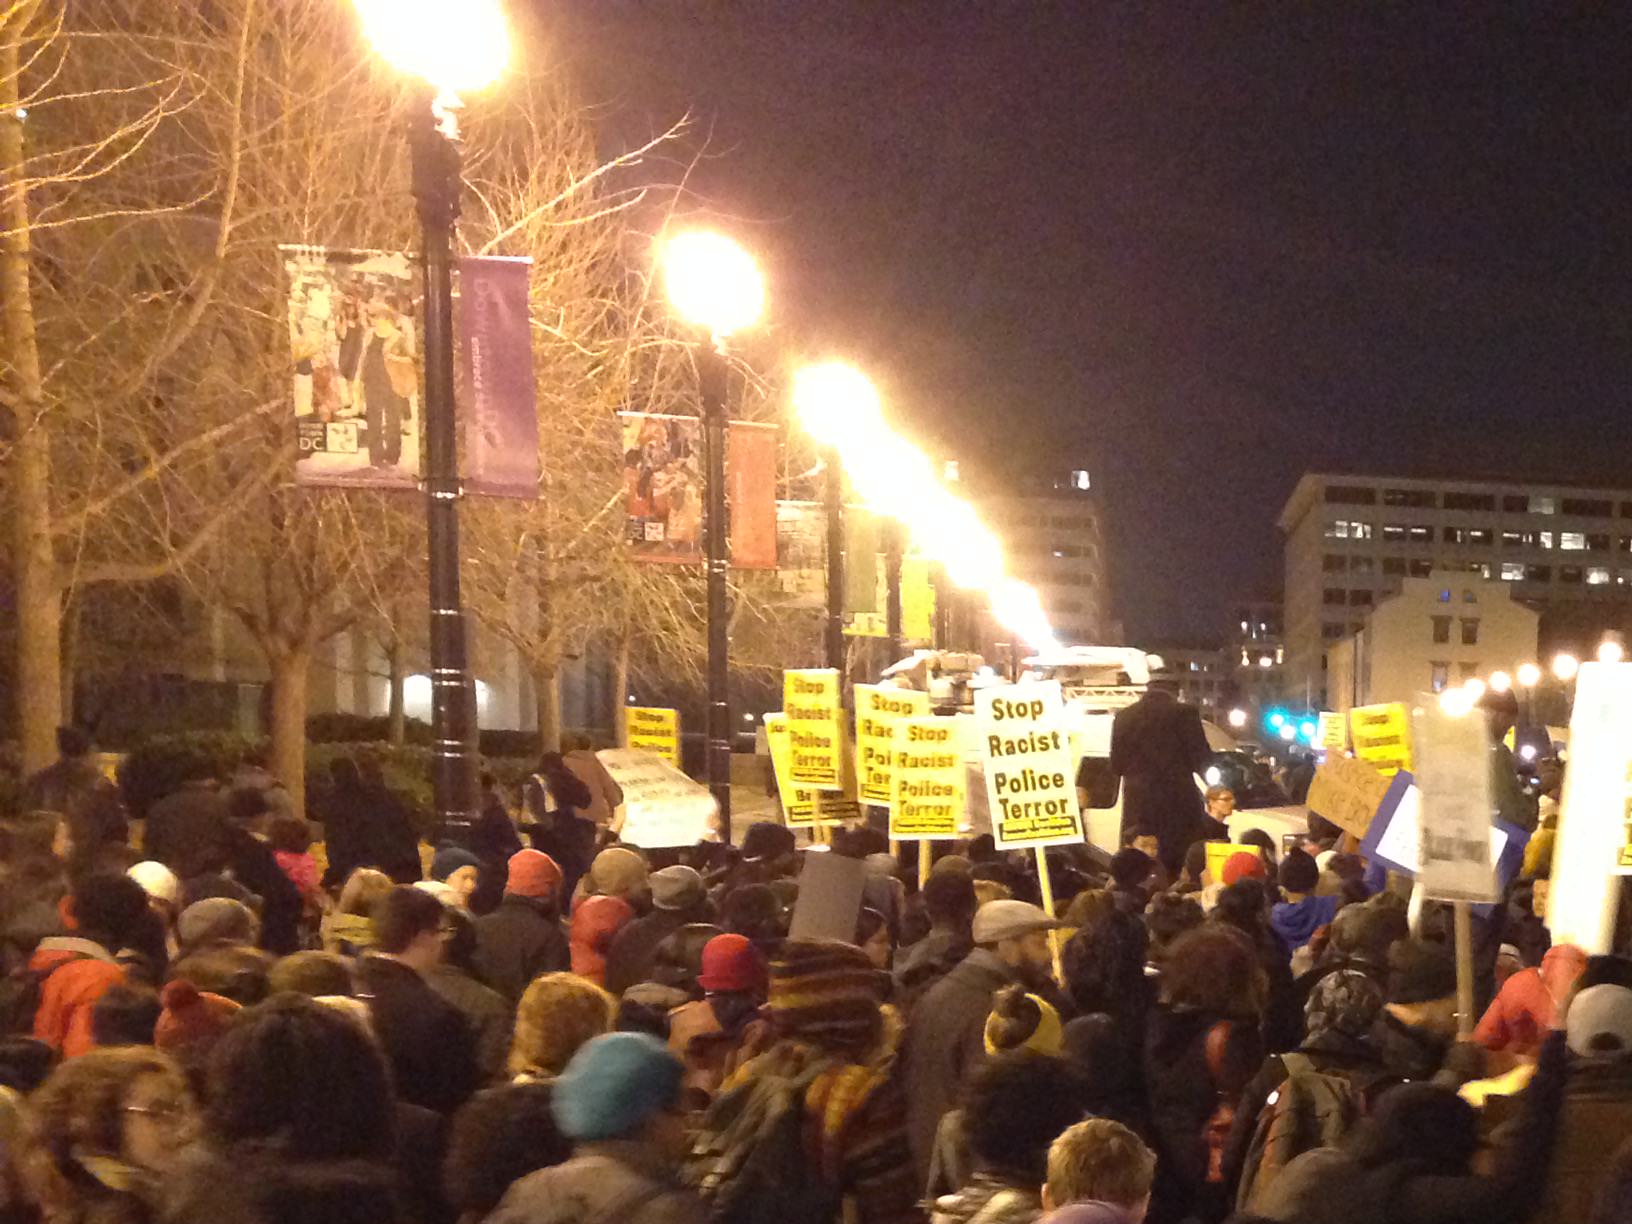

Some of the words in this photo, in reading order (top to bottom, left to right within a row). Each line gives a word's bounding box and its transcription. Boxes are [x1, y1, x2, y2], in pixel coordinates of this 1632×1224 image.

[299, 437, 323, 450] DC
[793, 677, 825, 695] Stop
[786, 703, 831, 720] Racist
[872, 694, 913, 715] Stop
[992, 698, 1044, 721] Stop
[862, 719, 893, 738] Rac
[908, 725, 948, 741] Stop
[789, 730, 831, 748] Police
[988, 731, 1060, 757] Racist
[792, 750, 831, 767] Terror
[898, 752, 955, 768] Racist
[899, 781, 953, 797] Police
[995, 769, 1064, 795] Police
[899, 800, 952, 816] Terror
[999, 798, 1068, 820] Terror
